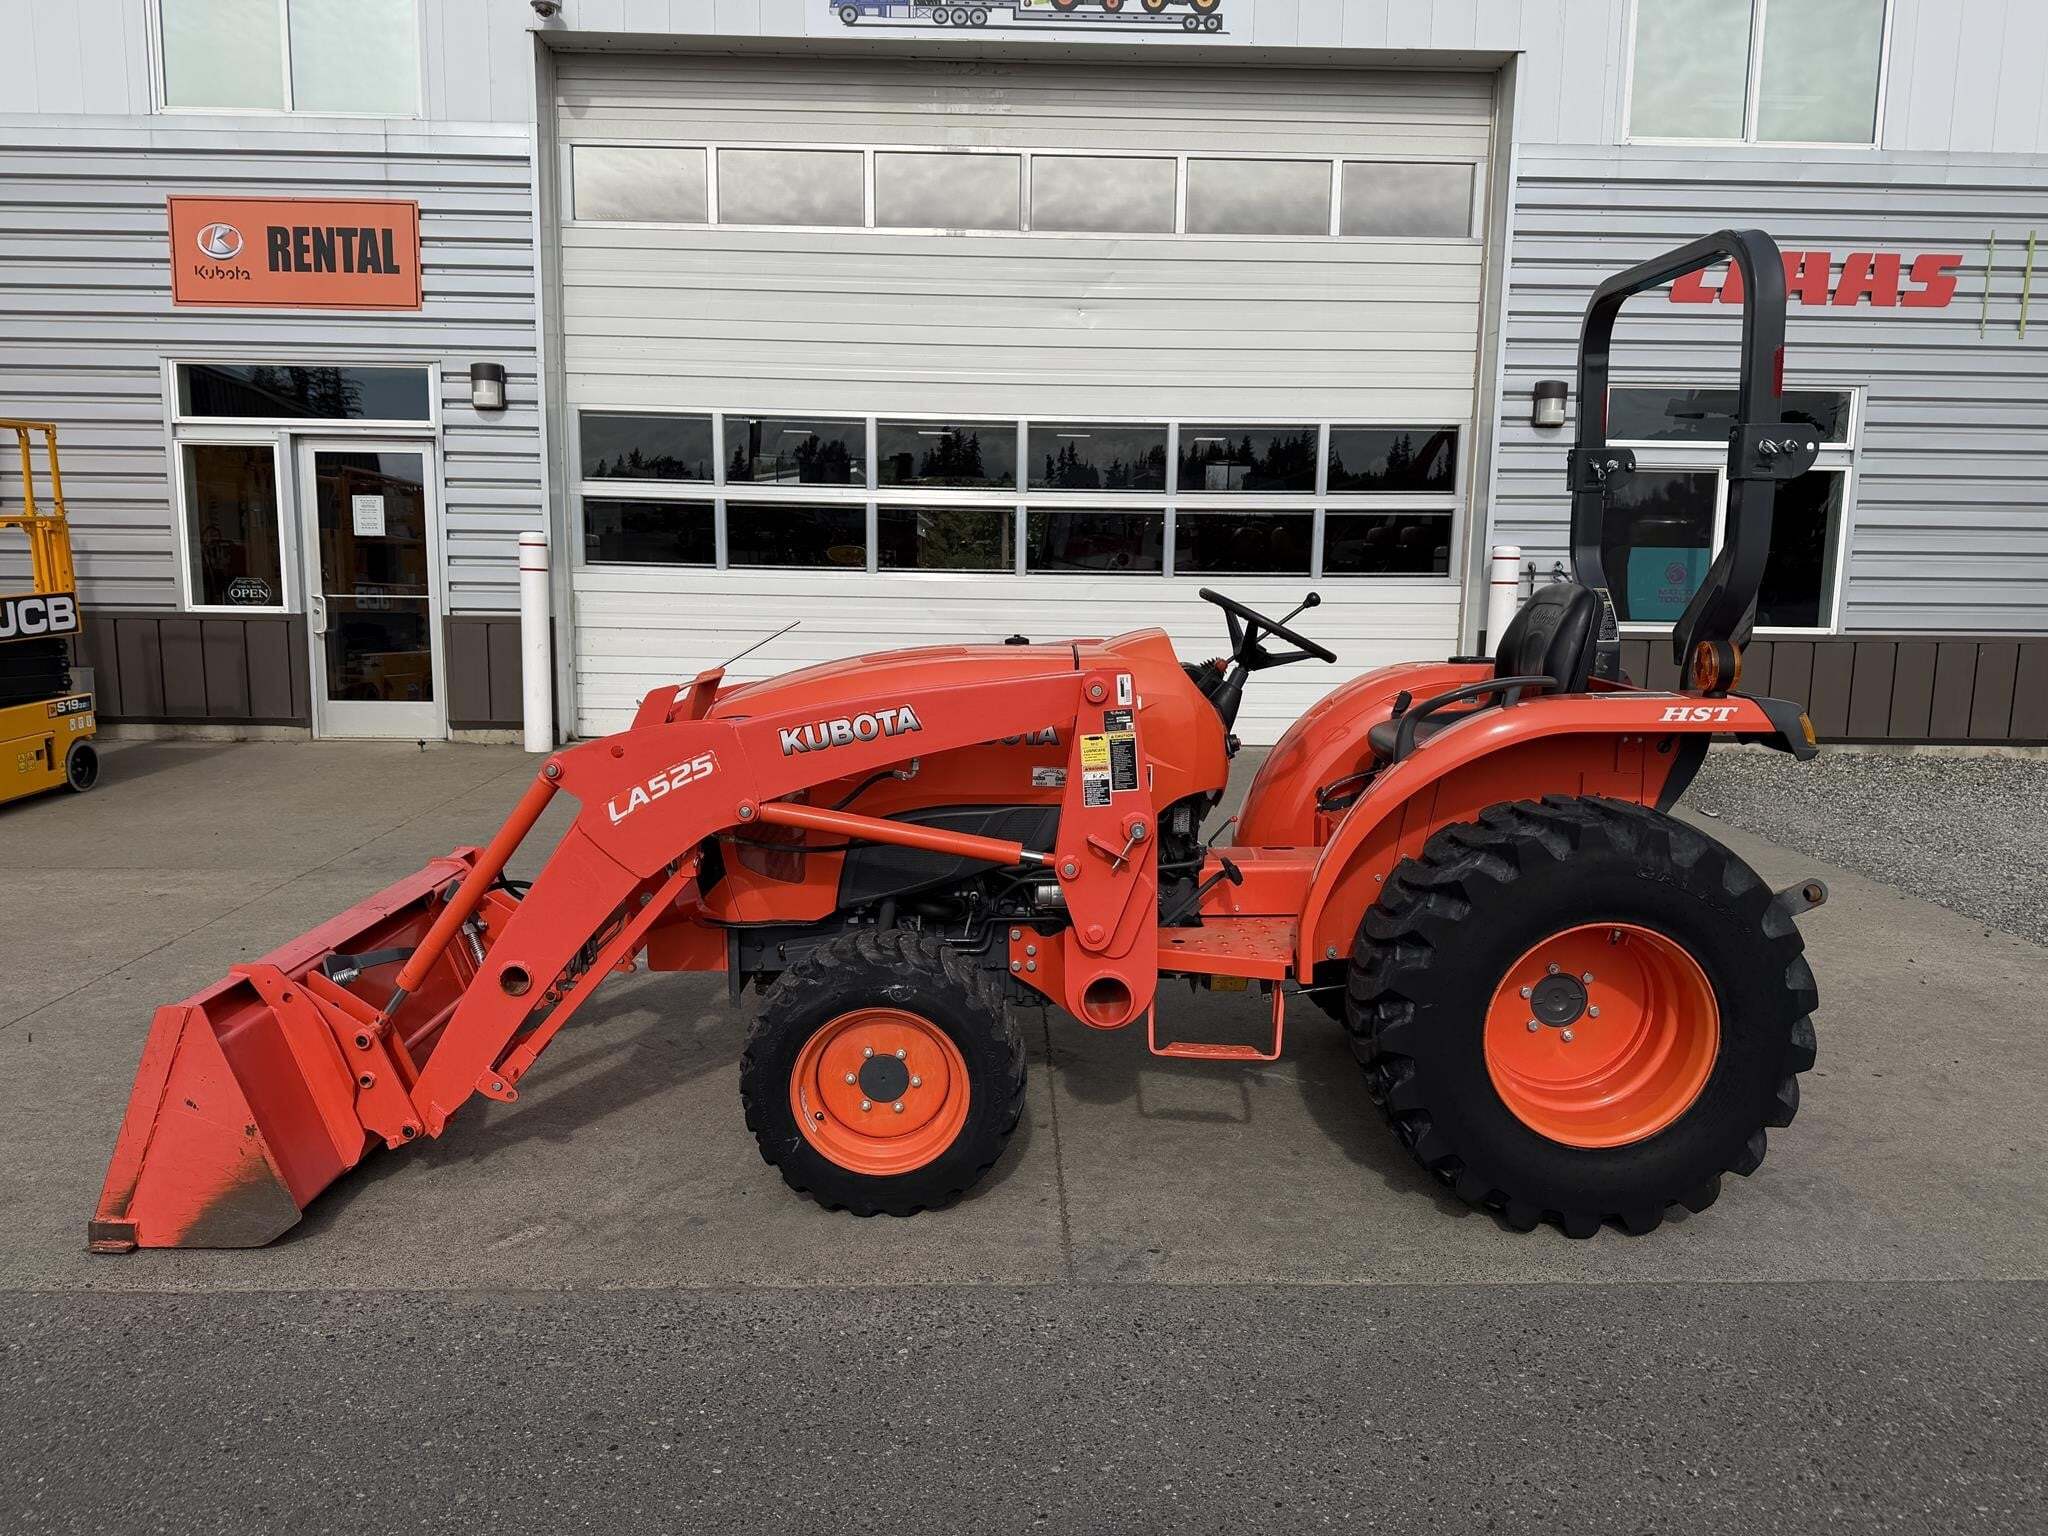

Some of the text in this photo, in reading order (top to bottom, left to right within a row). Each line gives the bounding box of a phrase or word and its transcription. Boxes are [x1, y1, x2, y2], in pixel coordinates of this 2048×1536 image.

[266, 225, 400, 275] RENTAL
[194, 265, 251, 281] Kubota
[230, 588, 268, 598] OPEN
[0, 596, 76, 638] JCB
[778, 703, 923, 756] KUBOTA
[1658, 706, 1738, 722] HST
[606, 754, 715, 824] LA525
